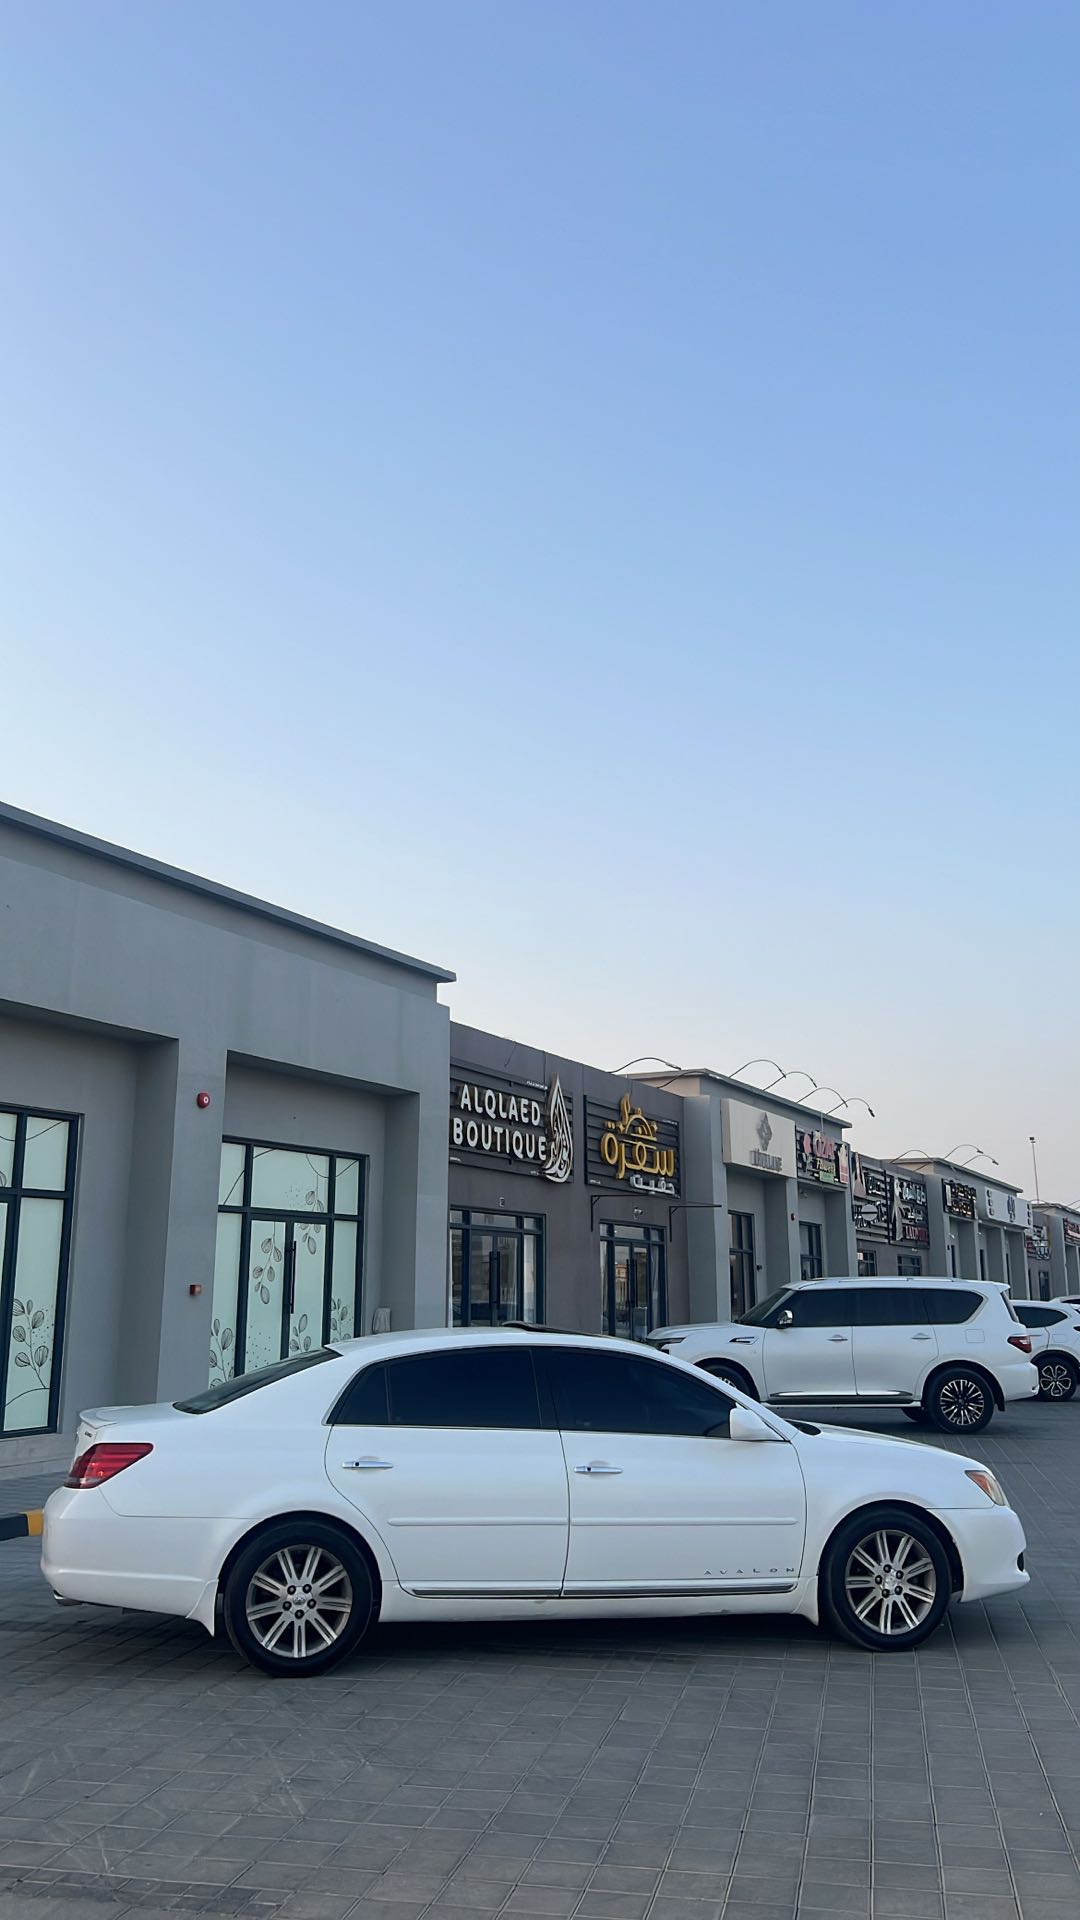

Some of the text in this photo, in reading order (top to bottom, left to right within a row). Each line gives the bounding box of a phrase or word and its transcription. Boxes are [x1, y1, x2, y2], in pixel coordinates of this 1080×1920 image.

[459, 1083, 541, 1127] ALQLAED
[452, 1116, 547, 1161] BOUTIQUE
[601, 1120, 675, 1180] سفرة
[703, 1567, 795, 1576] AVALON
